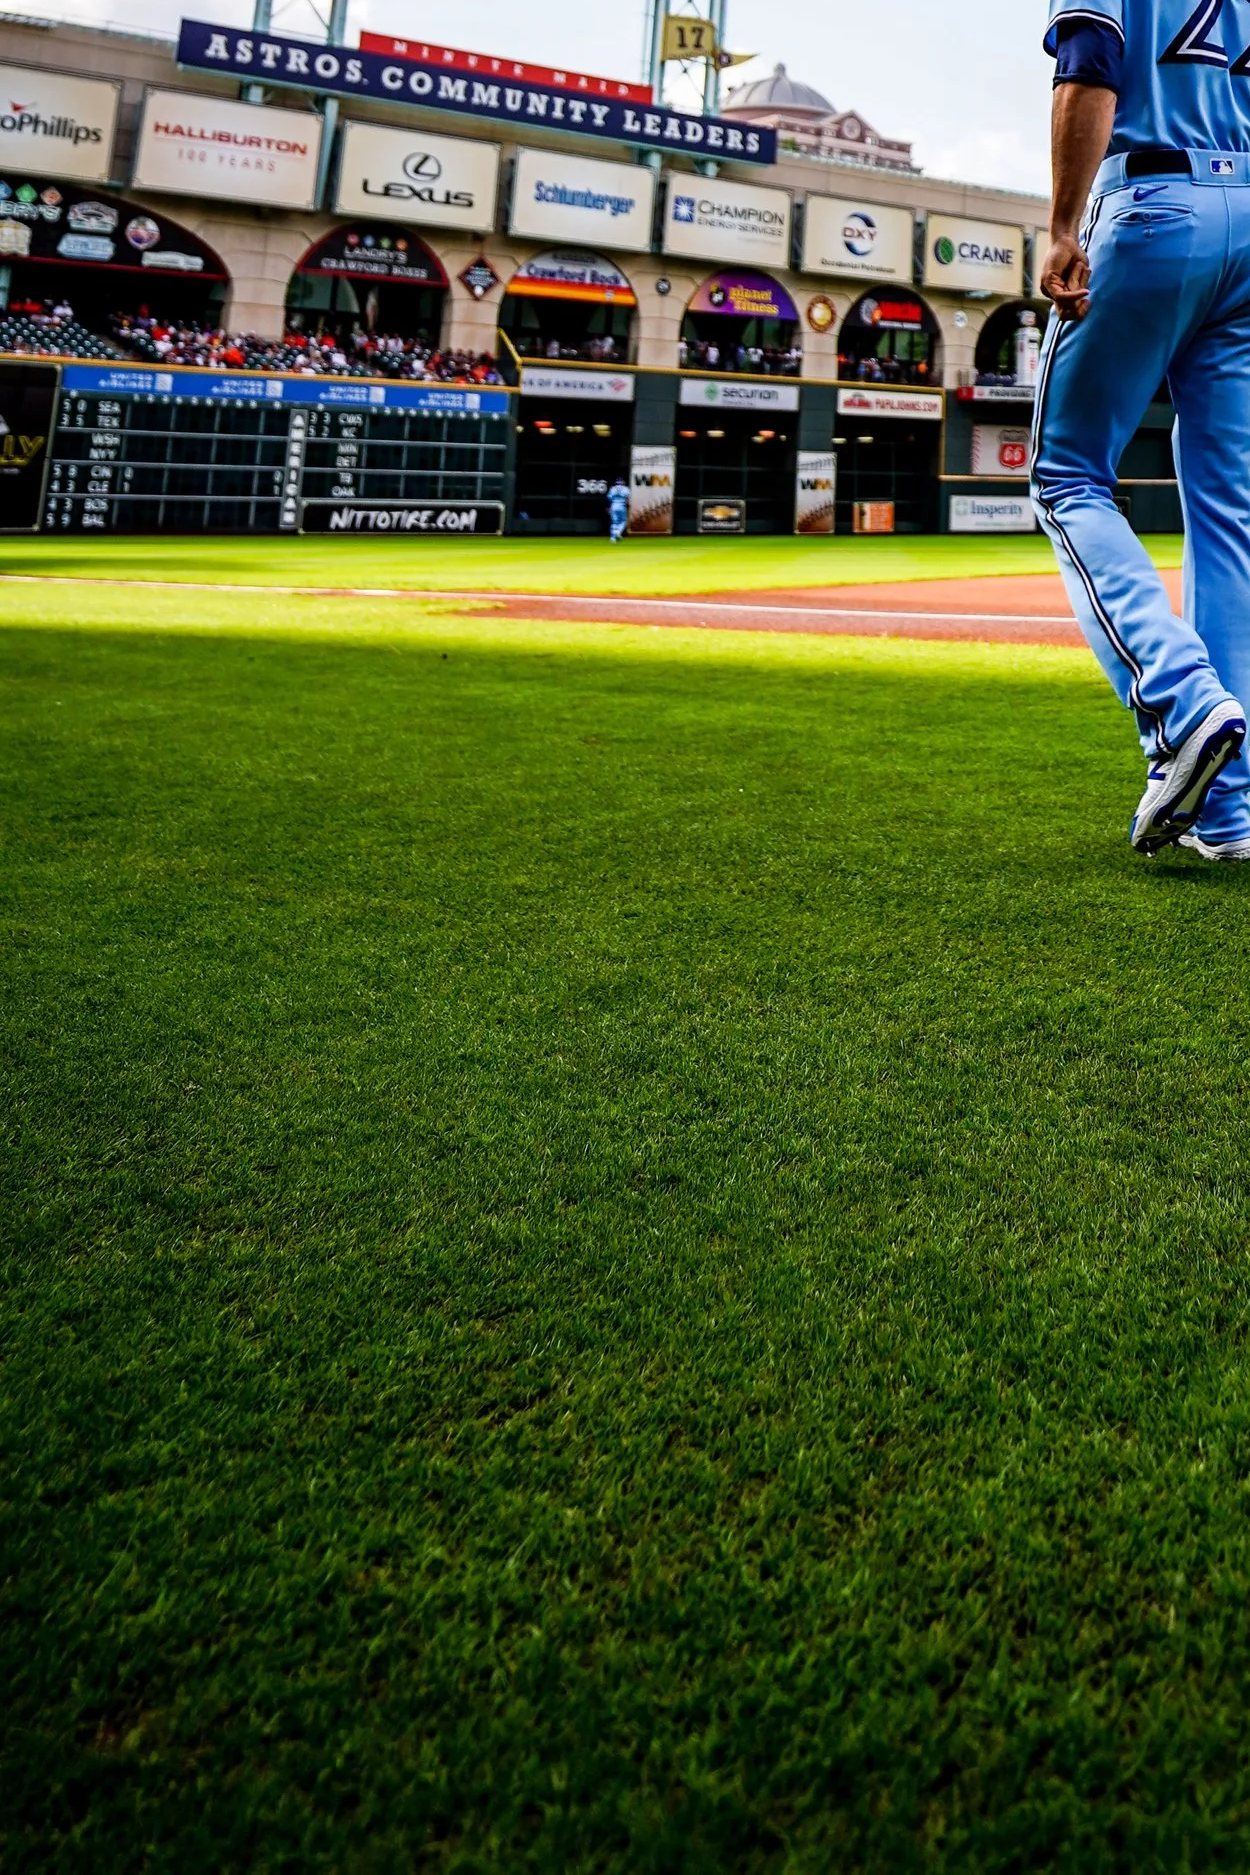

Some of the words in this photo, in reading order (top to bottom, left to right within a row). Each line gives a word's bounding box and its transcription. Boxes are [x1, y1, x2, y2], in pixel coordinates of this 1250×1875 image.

[677, 26, 704, 48] 17
[205, 33, 363, 82] ASTROS
[381, 65, 610, 126] COMMUNITY
[623, 109, 760, 153] LEADERS
[0, 113, 103, 146] oPhillips
[153, 120, 308, 156] HALLIBURTON
[218, 155, 276, 173] YEARS
[362, 178, 475, 209] LEXUS
[697, 199, 785, 226] CHAMPION
[843, 226, 877, 241] OXY
[958, 242, 1014, 265] CRANE
[1003, 445, 1024, 462] 66
[577, 478, 608, 494] 366
